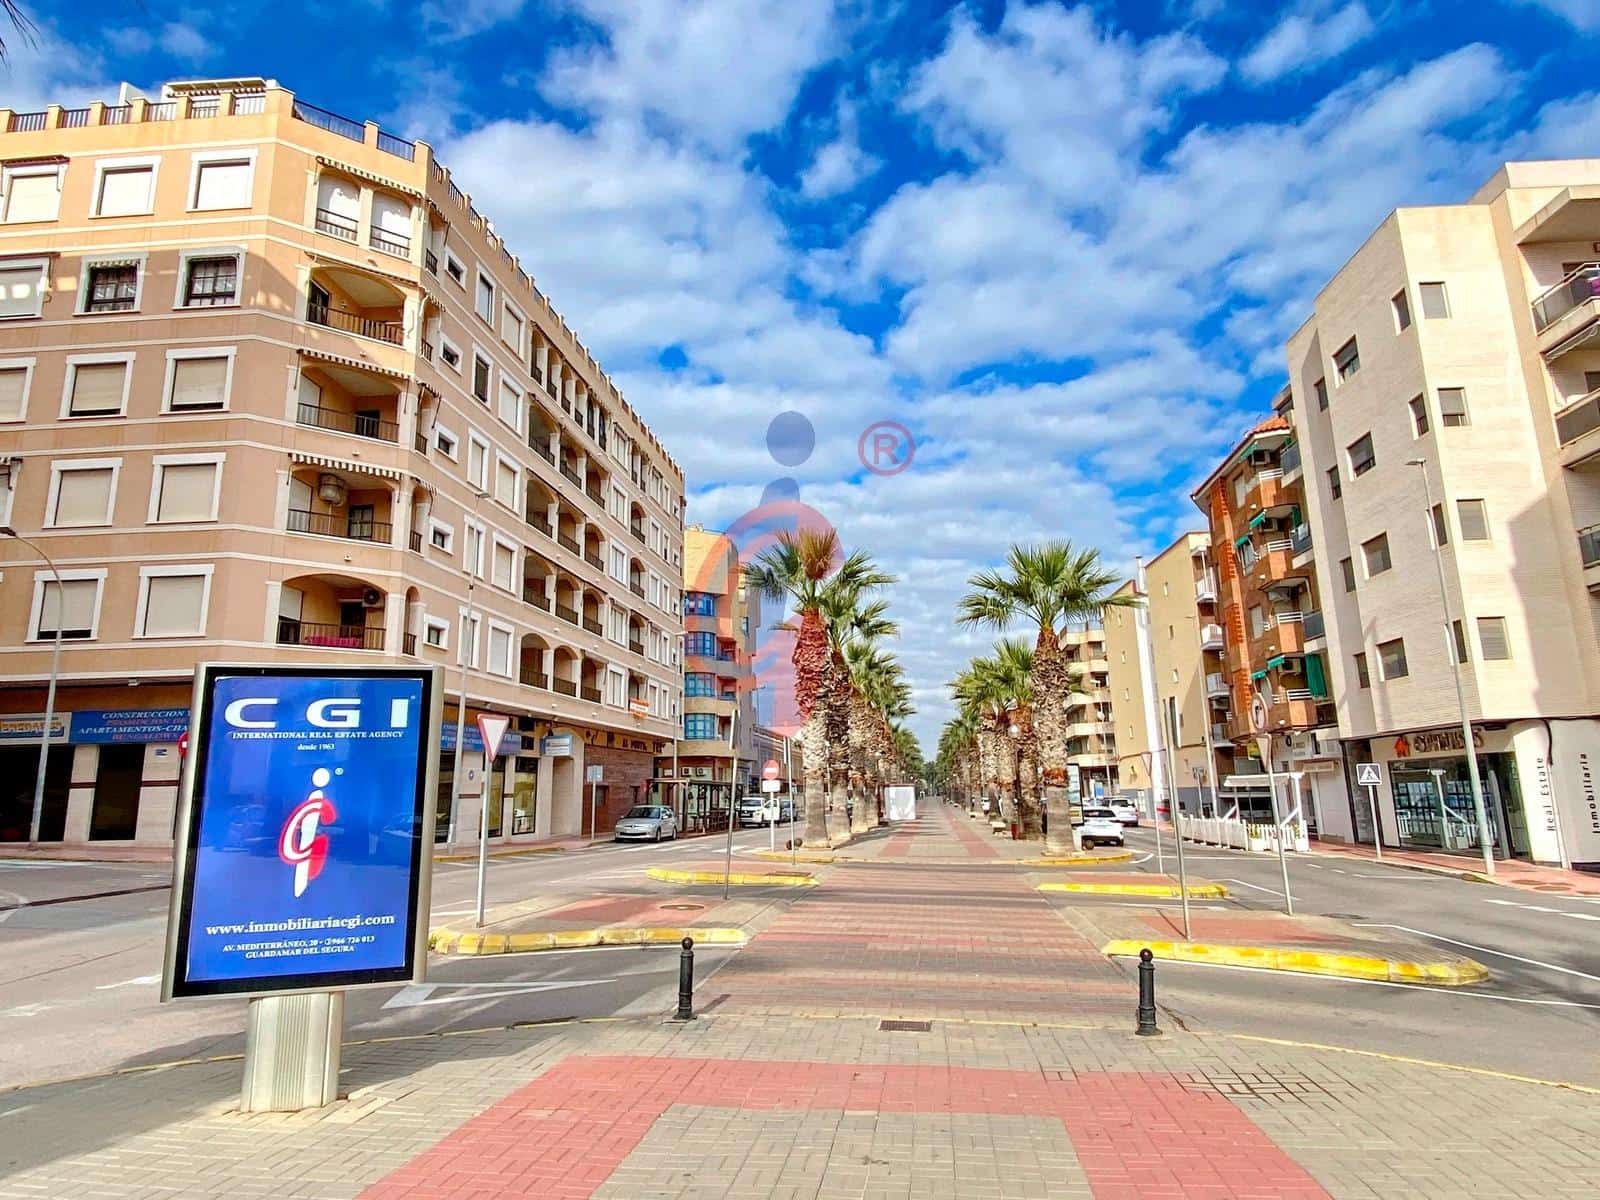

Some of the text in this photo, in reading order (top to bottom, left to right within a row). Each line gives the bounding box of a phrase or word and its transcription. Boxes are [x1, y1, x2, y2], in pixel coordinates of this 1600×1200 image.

[102, 711, 184, 719] CONSTRUCCION
[232, 731, 307, 740] INTERNATIONAL
[310, 731, 332, 739] REAL
[335, 731, 367, 739] ESTATE
[297, 743, 317, 751] desde
[1537, 758, 1556, 831] Real Estate
[1579, 753, 1600, 834] Inmobiliaria
[206, 914, 395, 935] www.inmobiliariacgi.com
[245, 945, 355, 959] GUARDAMAR DEL SEGURA
